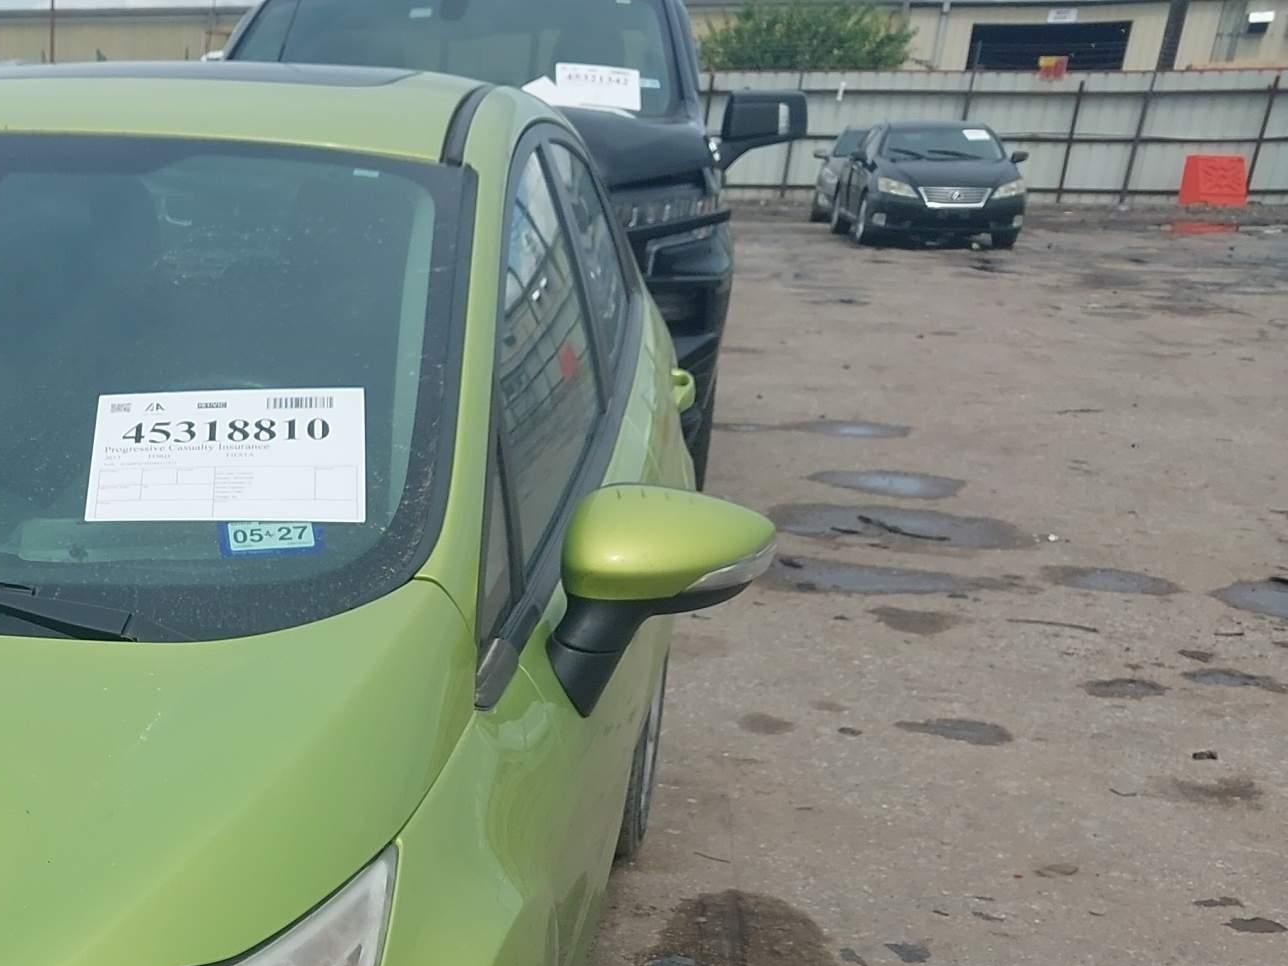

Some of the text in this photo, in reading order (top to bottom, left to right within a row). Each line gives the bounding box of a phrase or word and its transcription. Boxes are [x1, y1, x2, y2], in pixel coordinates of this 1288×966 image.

[121, 416, 330, 445] 45318810
[218, 442, 271, 451] Insurance
[233, 525, 308, 544] 05 27
